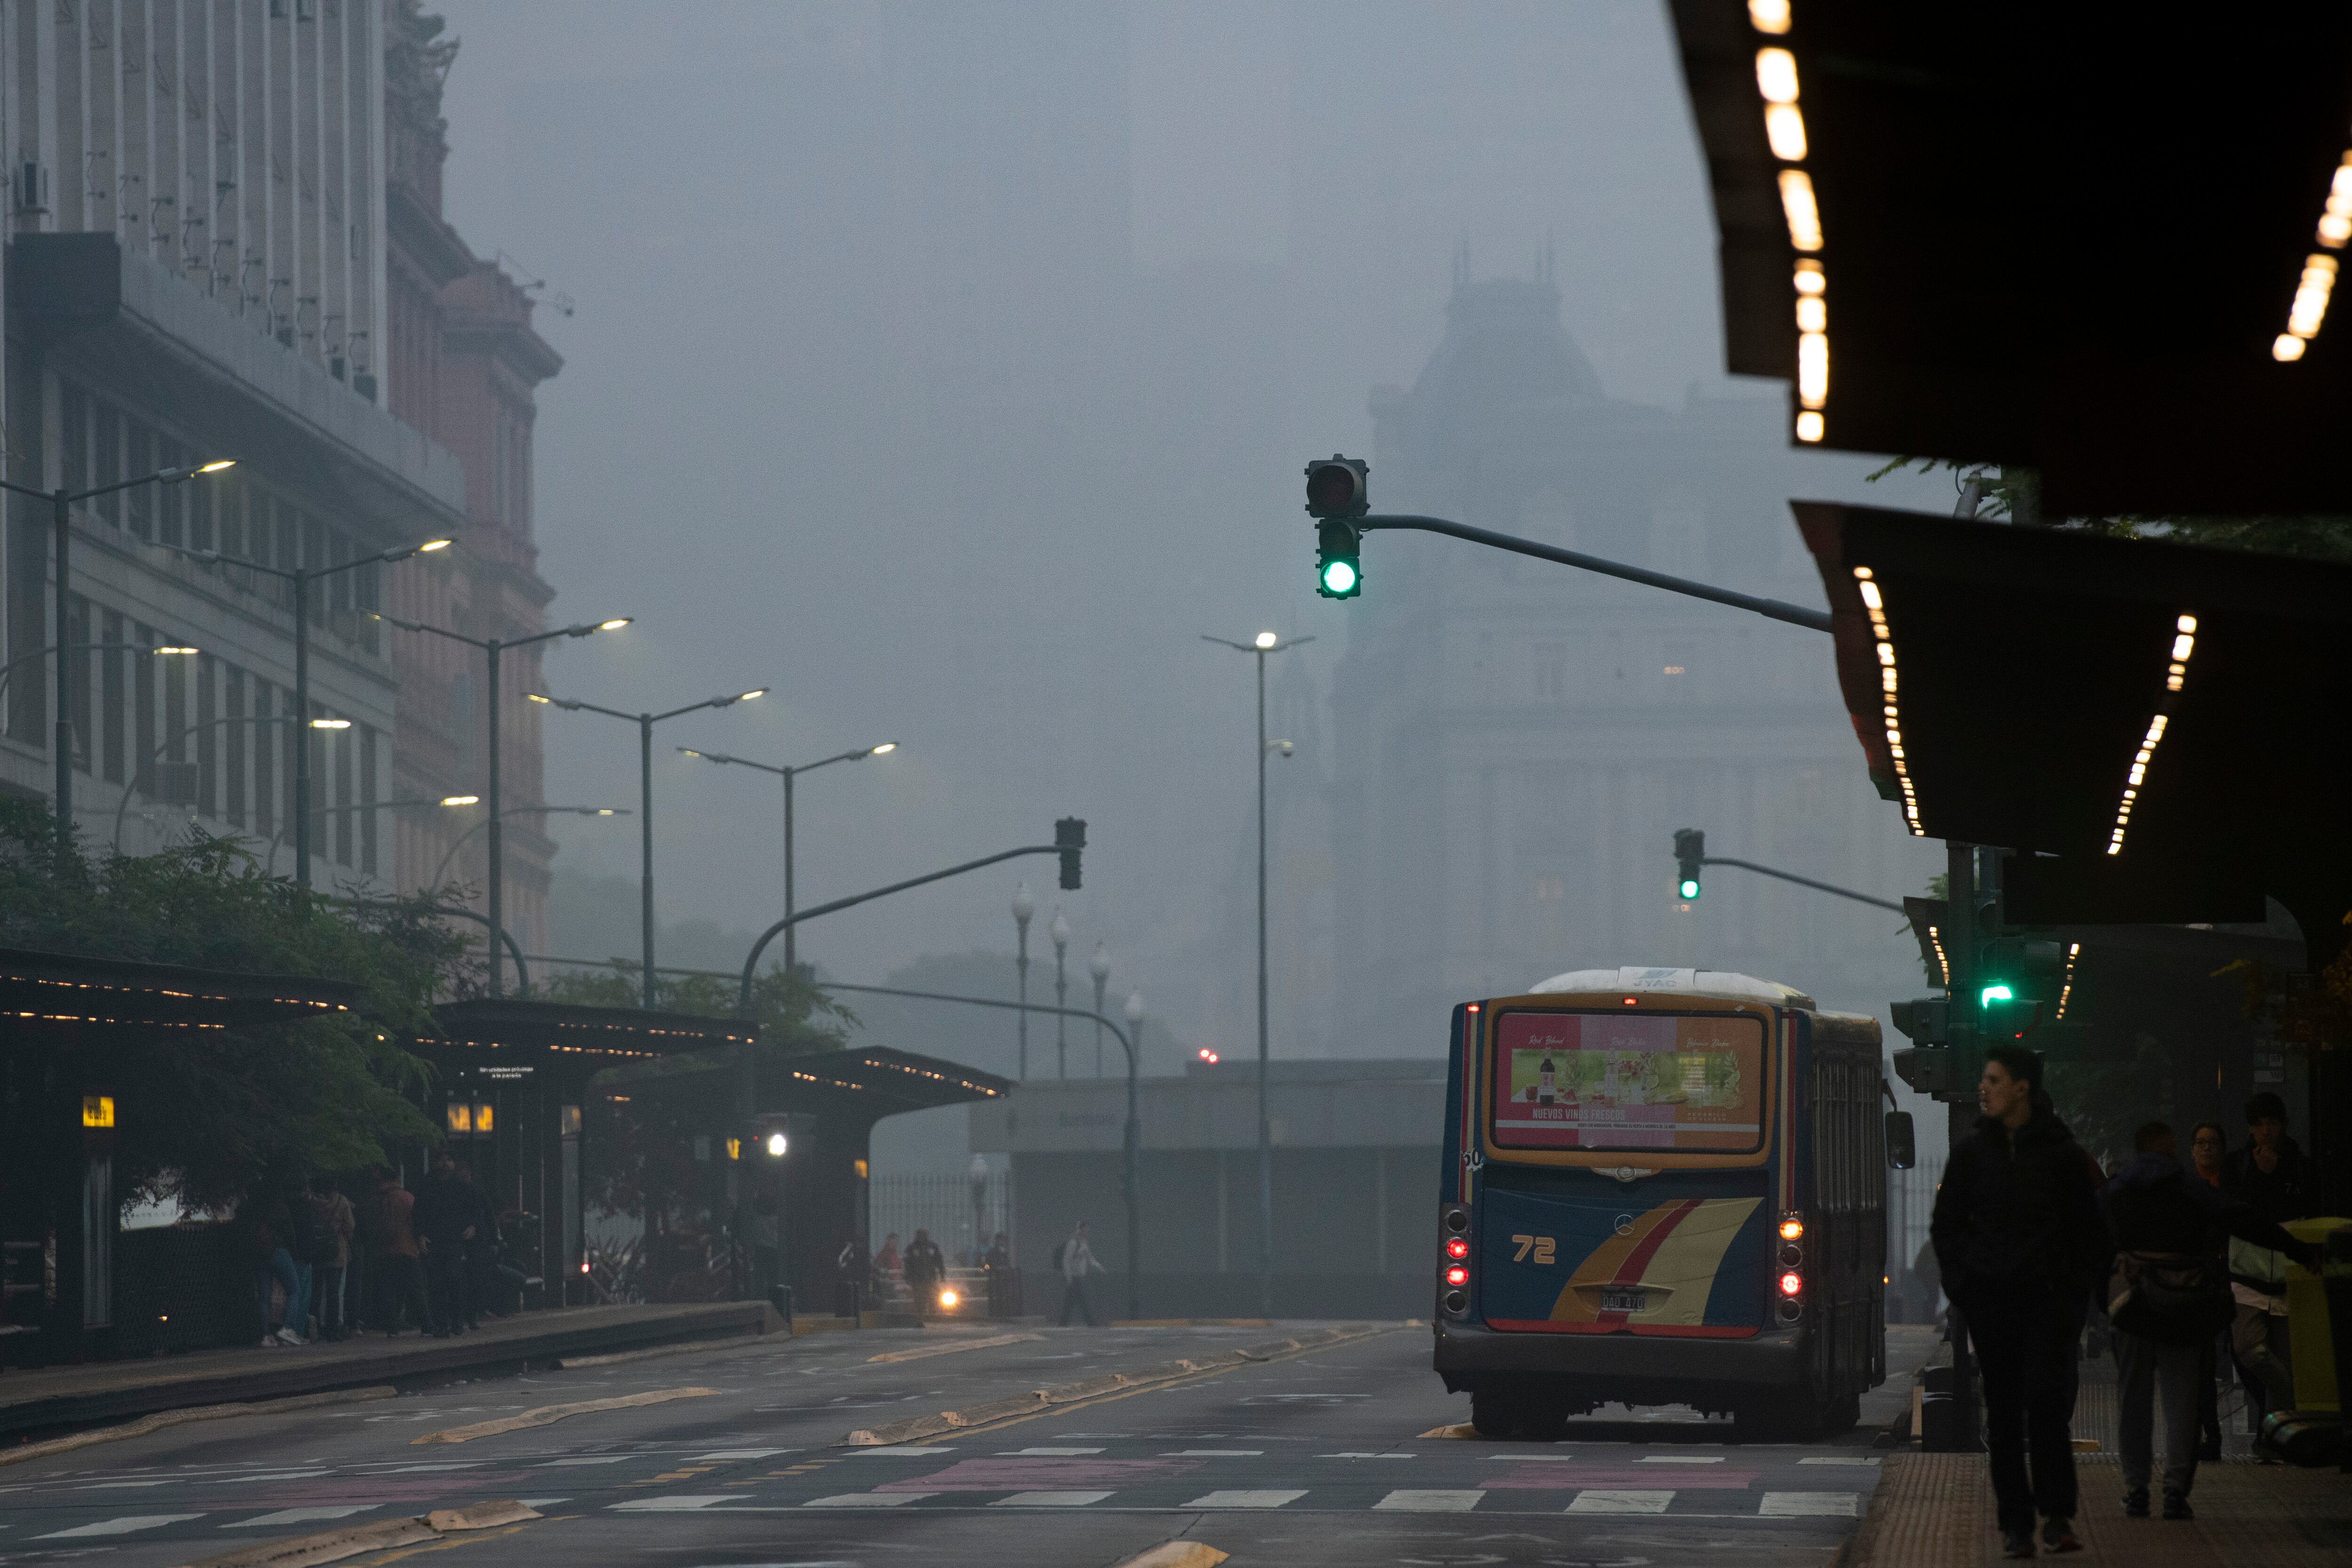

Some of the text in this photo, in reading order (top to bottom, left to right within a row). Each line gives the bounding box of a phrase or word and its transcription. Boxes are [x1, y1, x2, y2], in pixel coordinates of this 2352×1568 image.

[1528, 1035, 1565, 1045] Red Blend
[1533, 1108, 1626, 1120] NUEVOS VINOS FRESCOS
[1512, 1234, 1556, 1264] 72
[1625, 1297, 1643, 1308] 470
